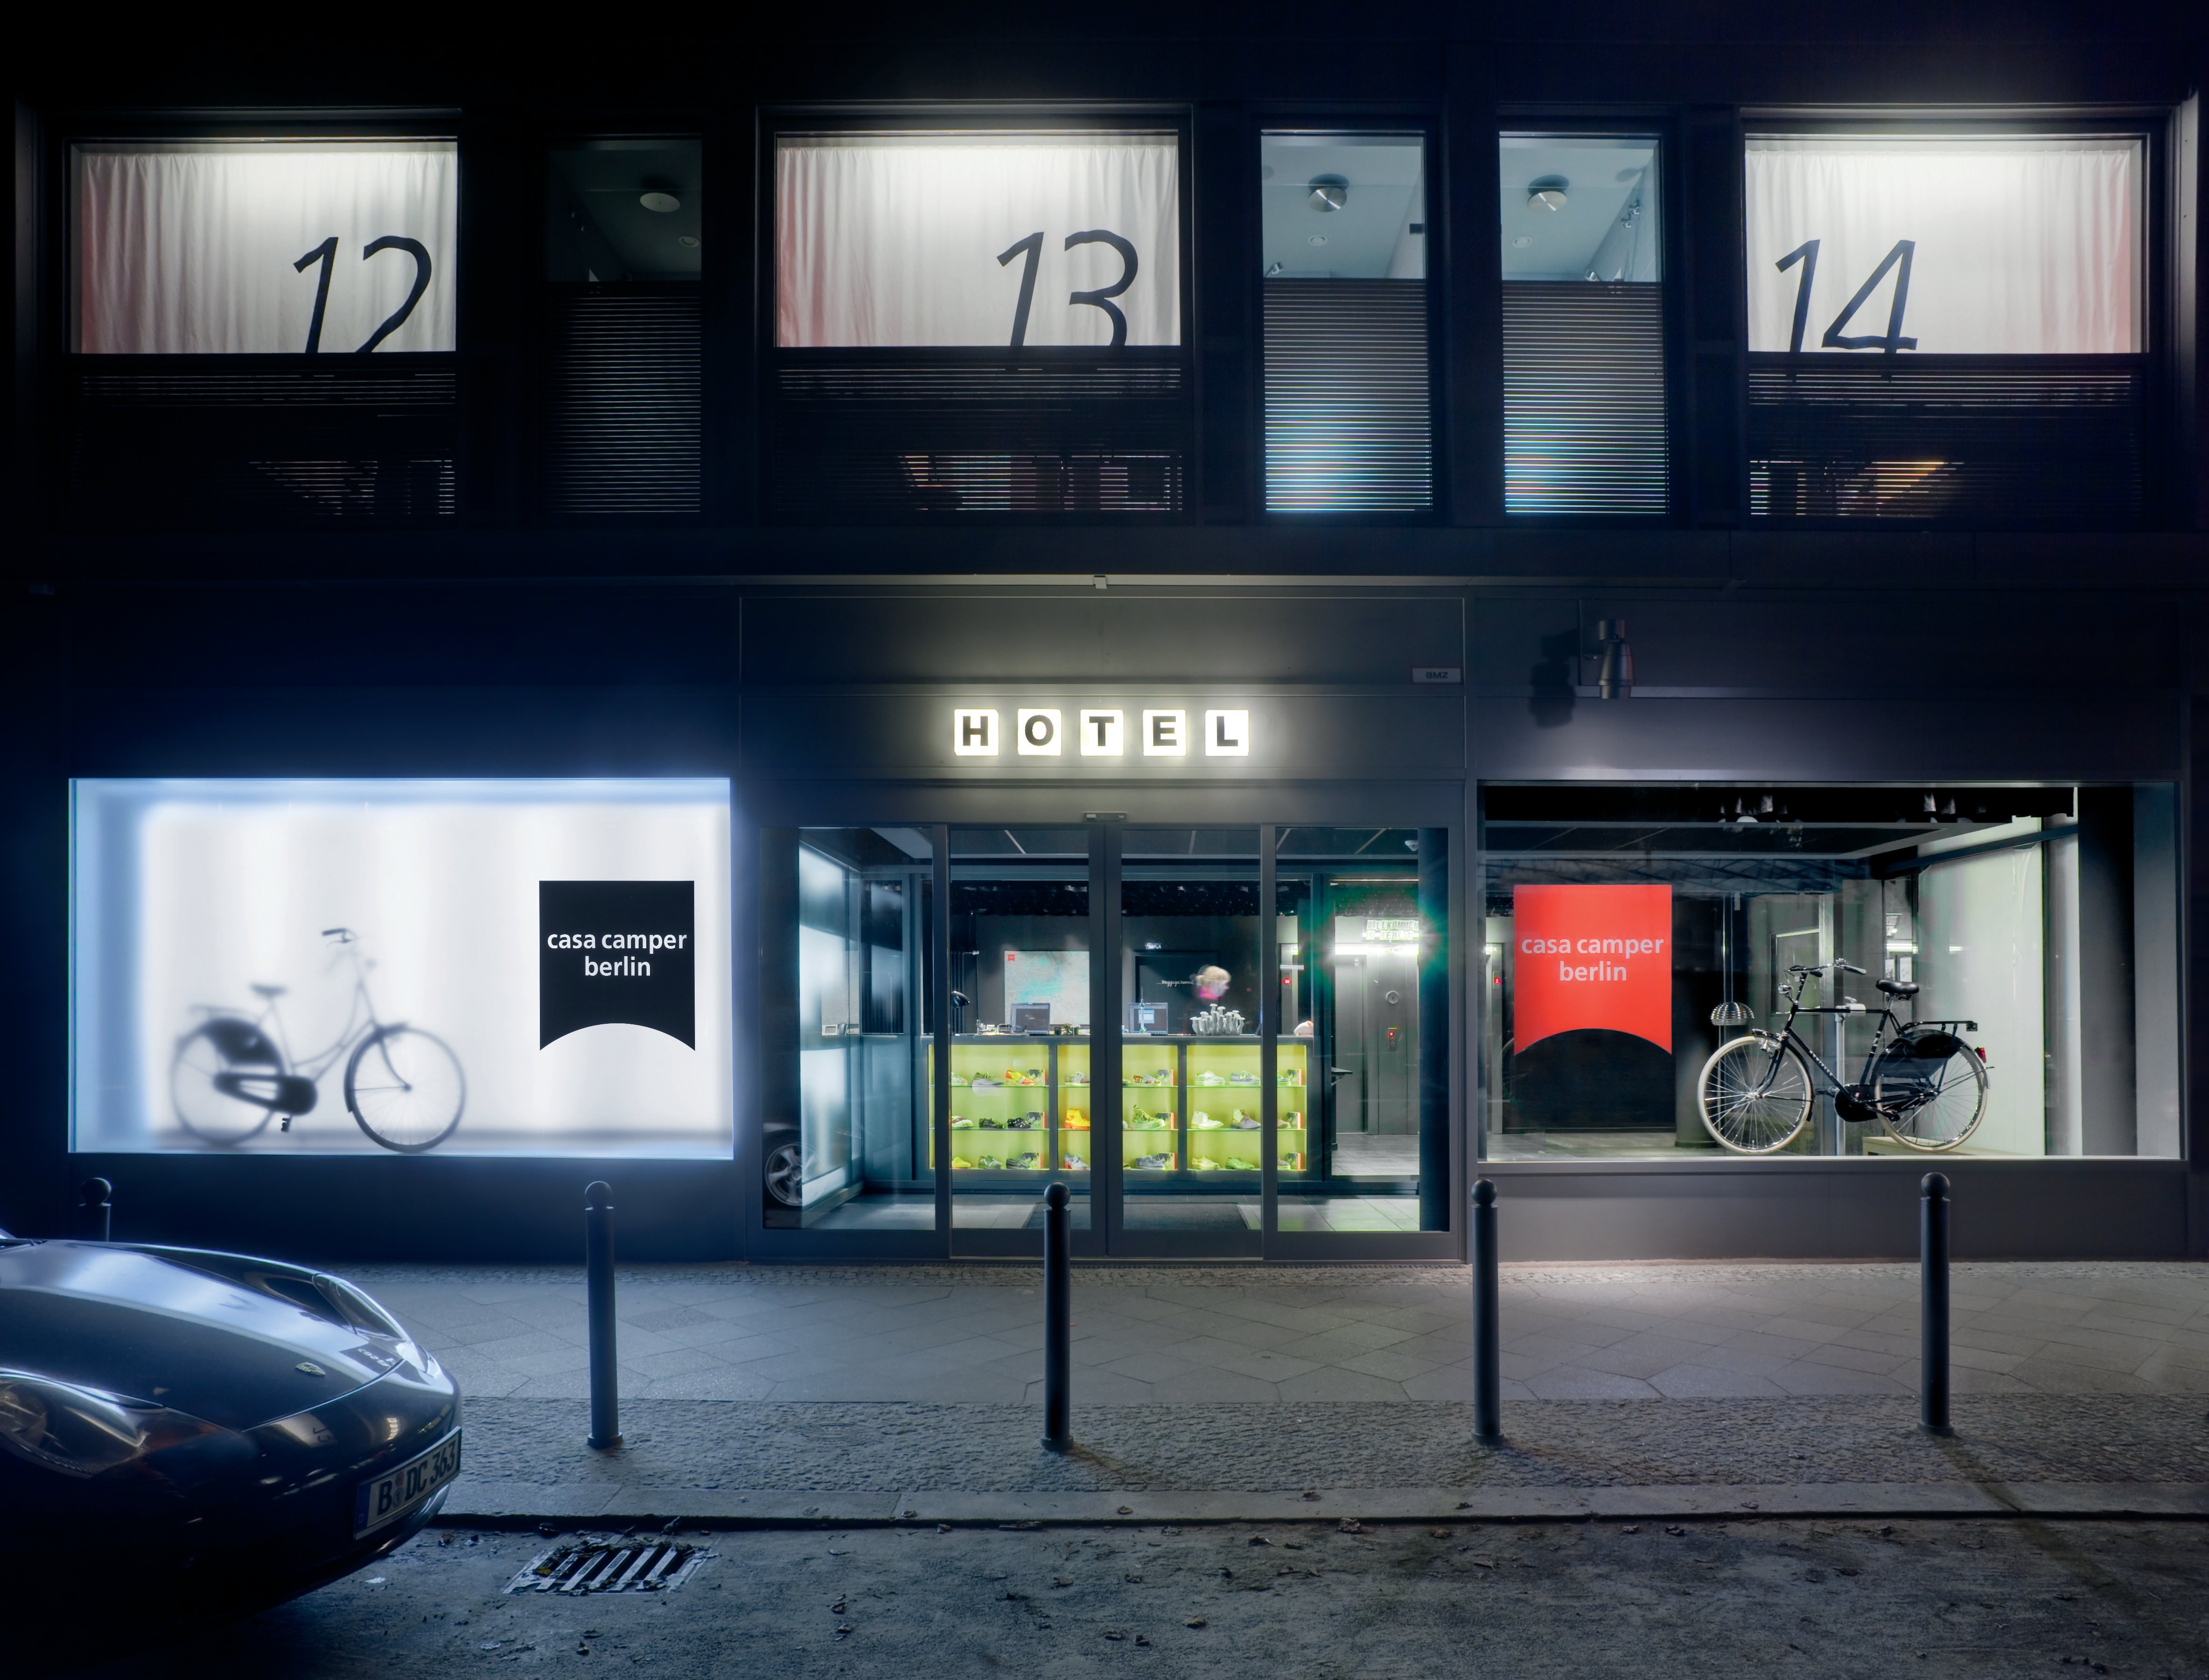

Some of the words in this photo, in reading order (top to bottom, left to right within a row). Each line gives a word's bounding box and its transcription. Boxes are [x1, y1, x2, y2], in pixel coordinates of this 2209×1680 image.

[293, 235, 432, 353] 12
[997, 229, 1138, 346] 13
[1775, 239, 1918, 353] 14
[962, 714, 1239, 747] HOTEL
[547, 934, 595, 949] casa
[601, 934, 687, 954] camper
[1521, 938, 1571, 954] casa
[1577, 938, 1664, 959] camper
[585, 956, 651, 976] berlin
[1559, 961, 1627, 981] berlin
[378, 1480, 392, 1515] B
[405, 1460, 427, 1501] DC
[430, 1441, 455, 1484] 363
